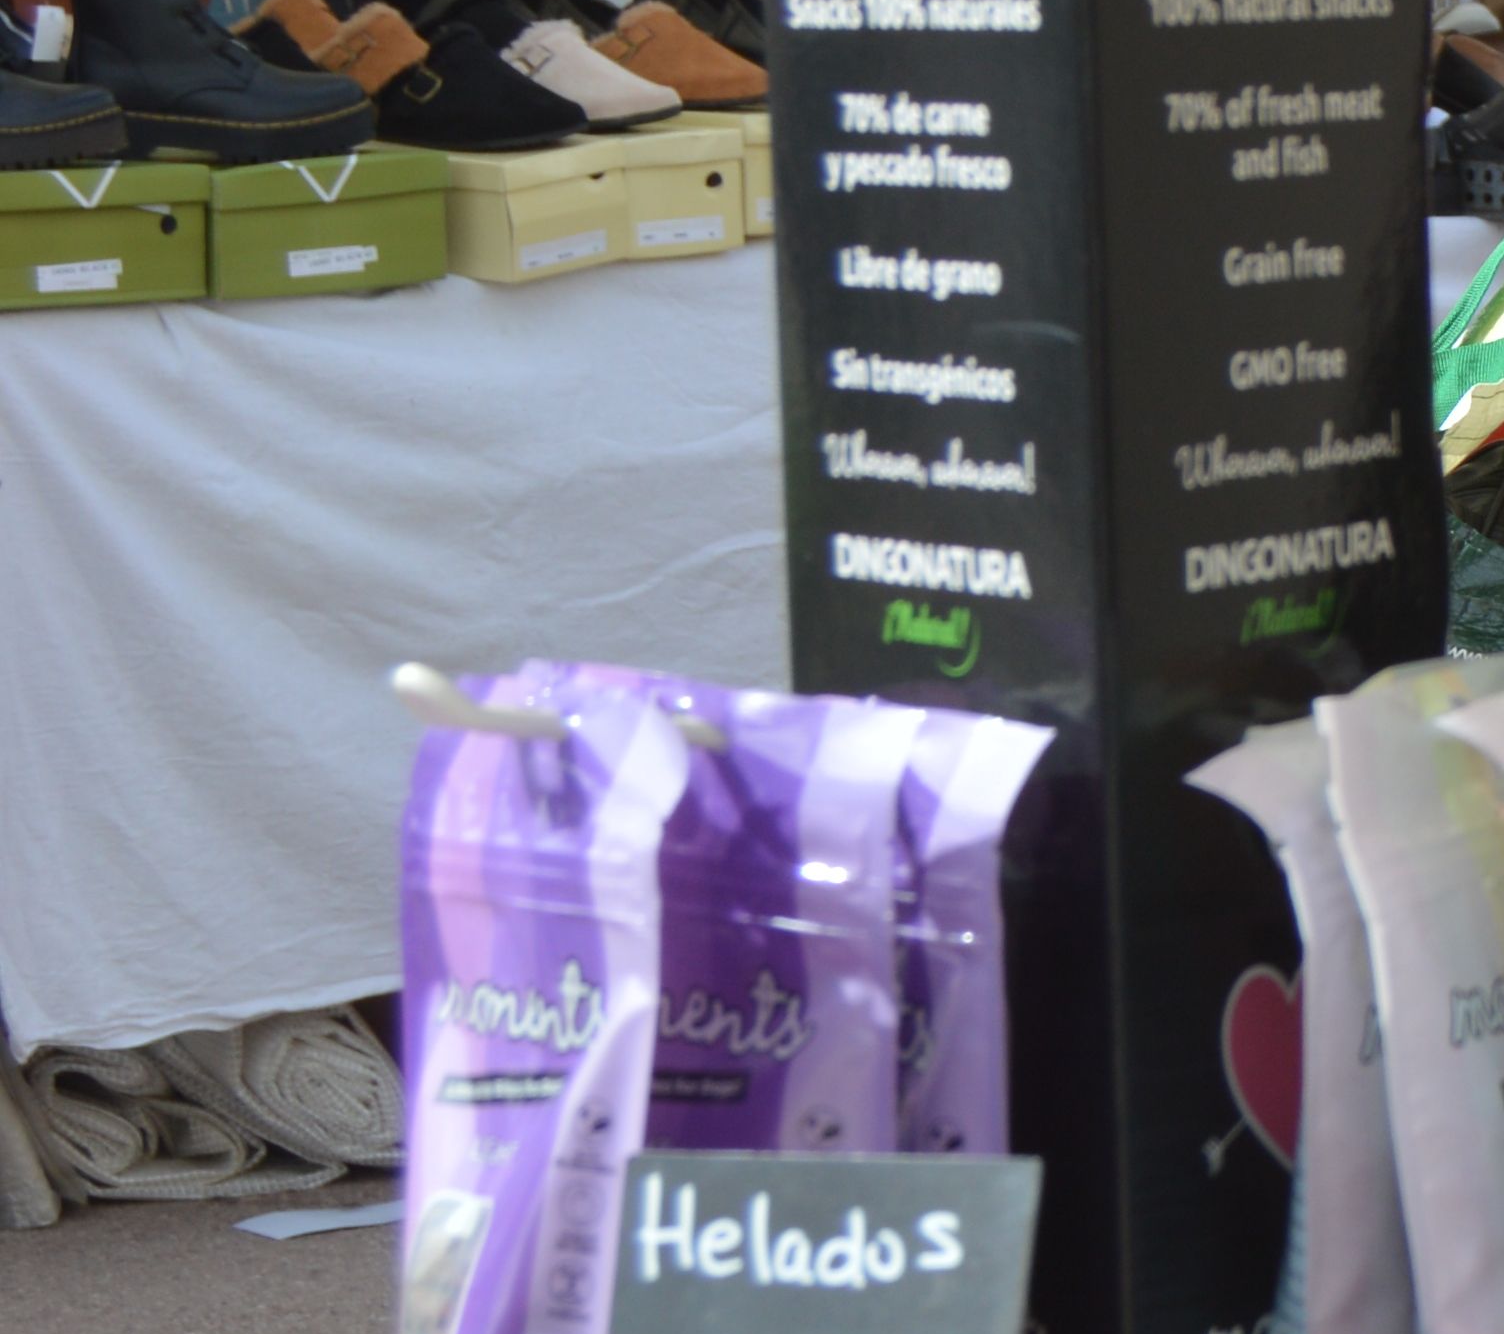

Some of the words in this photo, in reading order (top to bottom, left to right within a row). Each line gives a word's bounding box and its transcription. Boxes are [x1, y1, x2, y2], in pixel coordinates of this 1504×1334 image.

[837, 92, 890, 140] 70%
[892, 91, 922, 138] de
[924, 99, 990, 140] carne
[1164, 88, 1224, 132] 70%
[1225, 86, 1255, 127] of
[1256, 85, 1310, 127] fresh
[1314, 86, 1384, 123] meat
[822, 154, 840, 193] y
[841, 145, 932, 197] pescado
[933, 145, 1012, 193] fresco
[1232, 140, 1277, 183] and
[1279, 135, 1330, 178] fish
[836, 246, 898, 292] Libre
[898, 248, 931, 293] de
[932, 256, 1002, 301] grano
[1222, 243, 1288, 288] Grain
[1291, 240, 1345, 282] free
[830, 347, 868, 389] Sin
[868, 349, 1016, 405] transgénicos
[1229, 348, 1292, 392] GMO
[1294, 341, 1348, 384] free
[830, 531, 1034, 601] DINGONATURA
[1185, 518, 1395, 594] DINGONATURA
[635, 1170, 967, 1291] Helados
